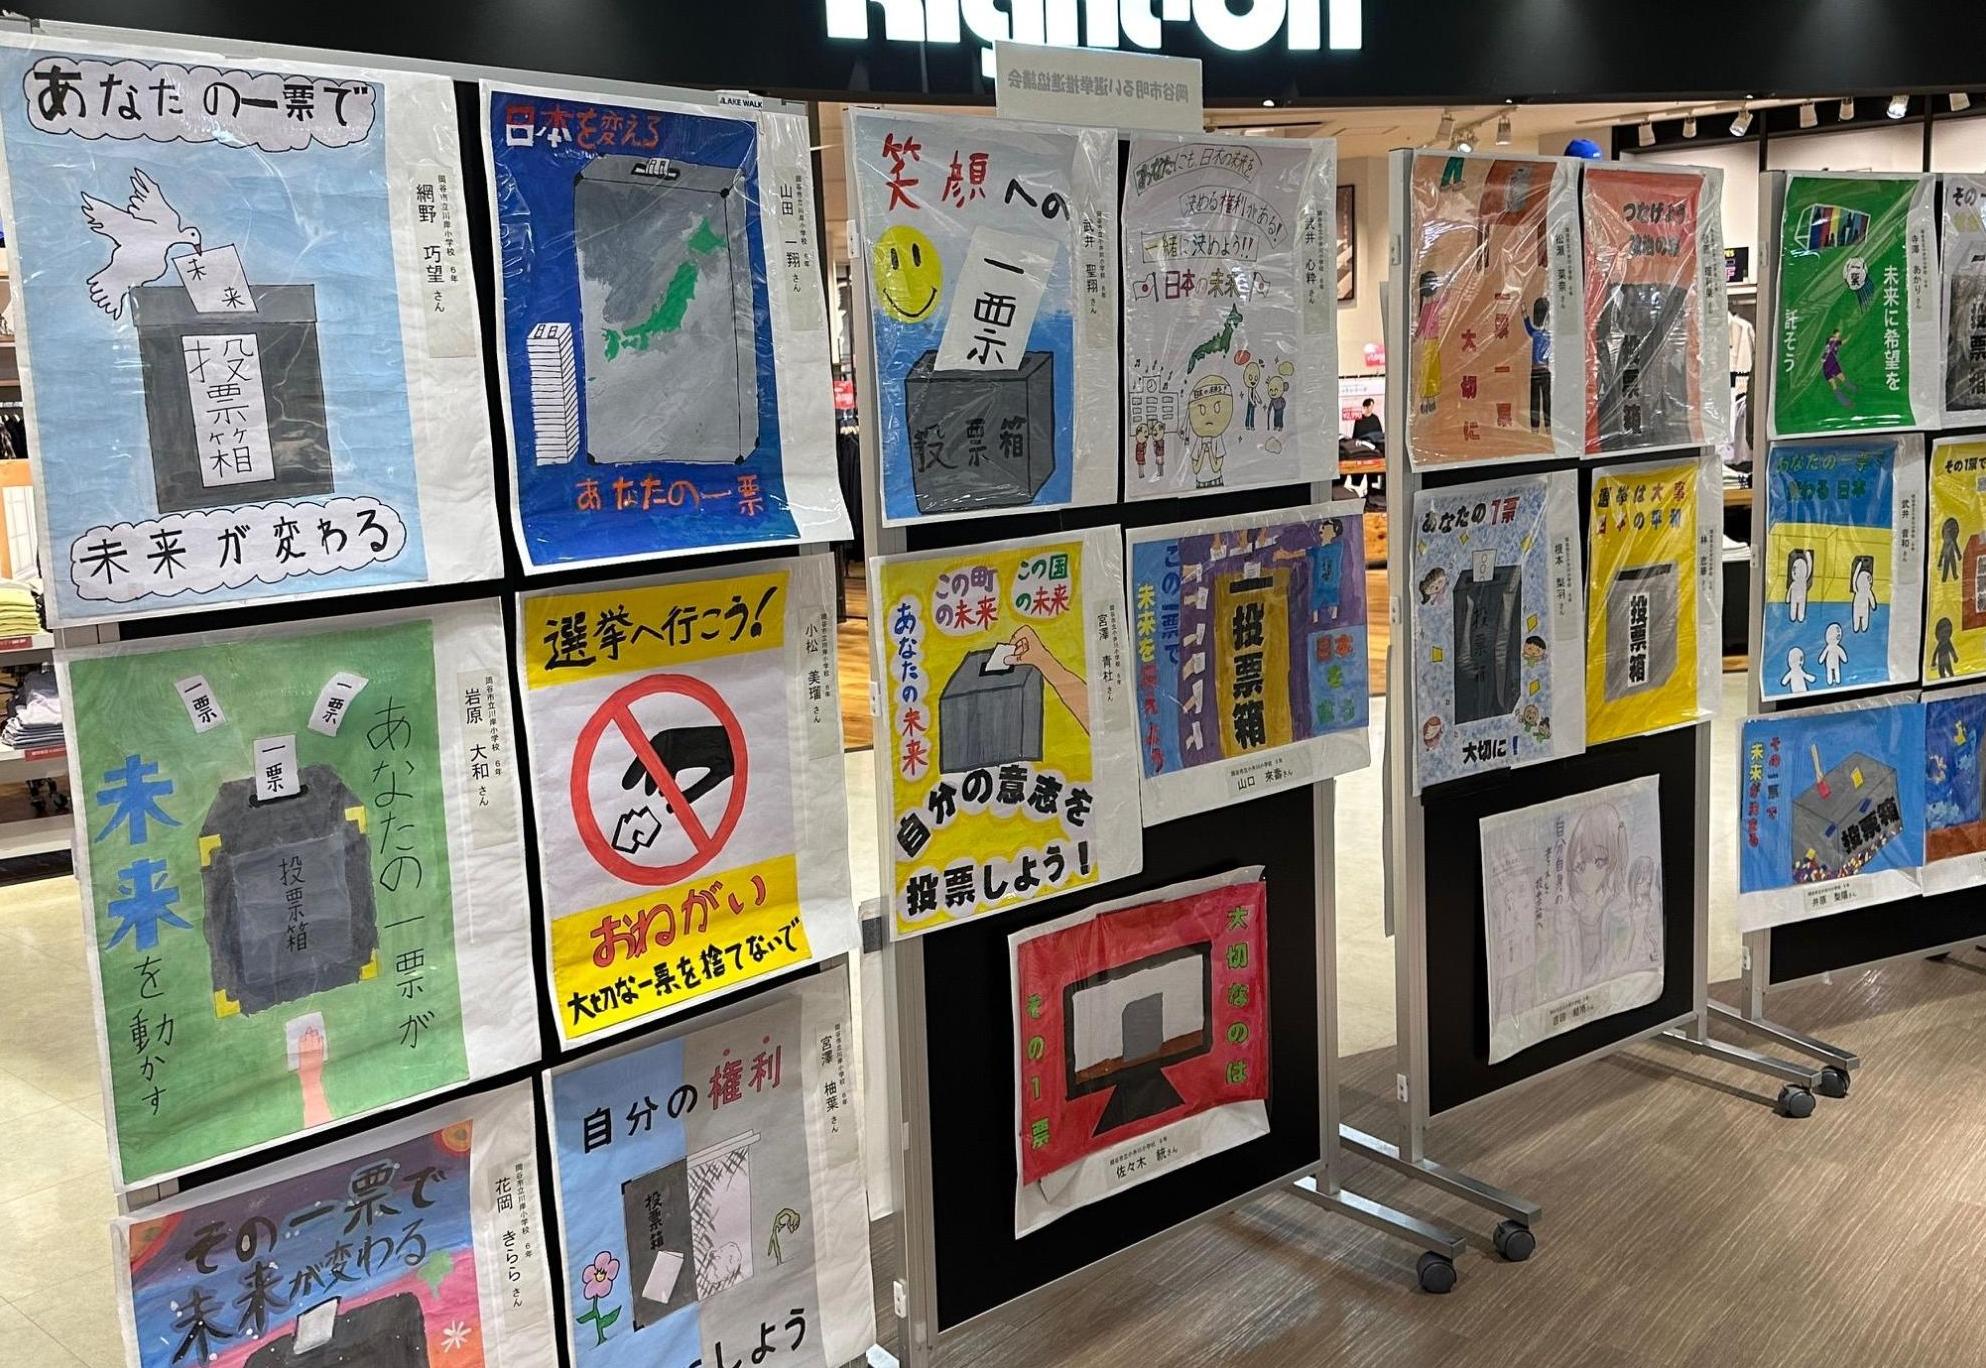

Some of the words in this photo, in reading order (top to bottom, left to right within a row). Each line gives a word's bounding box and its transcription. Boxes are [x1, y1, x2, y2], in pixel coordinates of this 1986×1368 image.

[34, 66, 368, 126] あなたの一票で
[723, 97, 741, 106] LAKE
[743, 100, 763, 108] WALK
[416, 184, 437, 223] 網野
[780, 184, 794, 215] 山田
[882, 133, 1071, 222] 笑顔への
[187, 259, 246, 308] 未来
[967, 257, 1025, 365] 一票
[1883, 265, 1901, 391] 未来に希望を
[185, 339, 254, 478] 投票箱
[1460, 328, 1480, 441] 大切に
[914, 416, 1028, 473] 投票箱
[576, 474, 763, 517] あなたの一票
[1421, 496, 1521, 534] あなたの1票
[80, 509, 389, 584] 未来が変わる
[1016, 552, 1069, 582] この国
[935, 565, 998, 600] この町
[935, 599, 999, 632] の未来
[1016, 584, 1070, 615] の未来
[543, 586, 778, 670] 選挙へ行こう!
[805, 623, 819, 654] 小松
[1628, 594, 1649, 684] 投票箱
[184, 681, 218, 723] 一票
[322, 682, 353, 724] 一票
[464, 688, 483, 724] 岩原
[893, 602, 931, 777] あなたの未来
[1232, 602, 1266, 750] 投票箱
[261, 746, 287, 792] 一票
[1237, 775, 1256, 791] 山口
[1462, 735, 1519, 765] 大切に!
[896, 765, 1094, 859] 自分の意志を
[278, 855, 308, 952] 投票箱
[366, 696, 435, 1048] あなたの一票が
[905, 840, 1090, 917] 投票しよう!
[94, 754, 194, 1116] 未来を動かす
[589, 874, 767, 968] おねがい
[566, 916, 801, 1026] 大切な一票を捨てないで
[1224, 906, 1249, 1084] 大切なのは
[583, 1042, 783, 1154] 自分の権利
[495, 1176, 513, 1213] 花岡
[1116, 1157, 1147, 1179] 佐々木
[185, 1163, 447, 1275] その一票で
[171, 1219, 428, 1366] 未来が変わる
